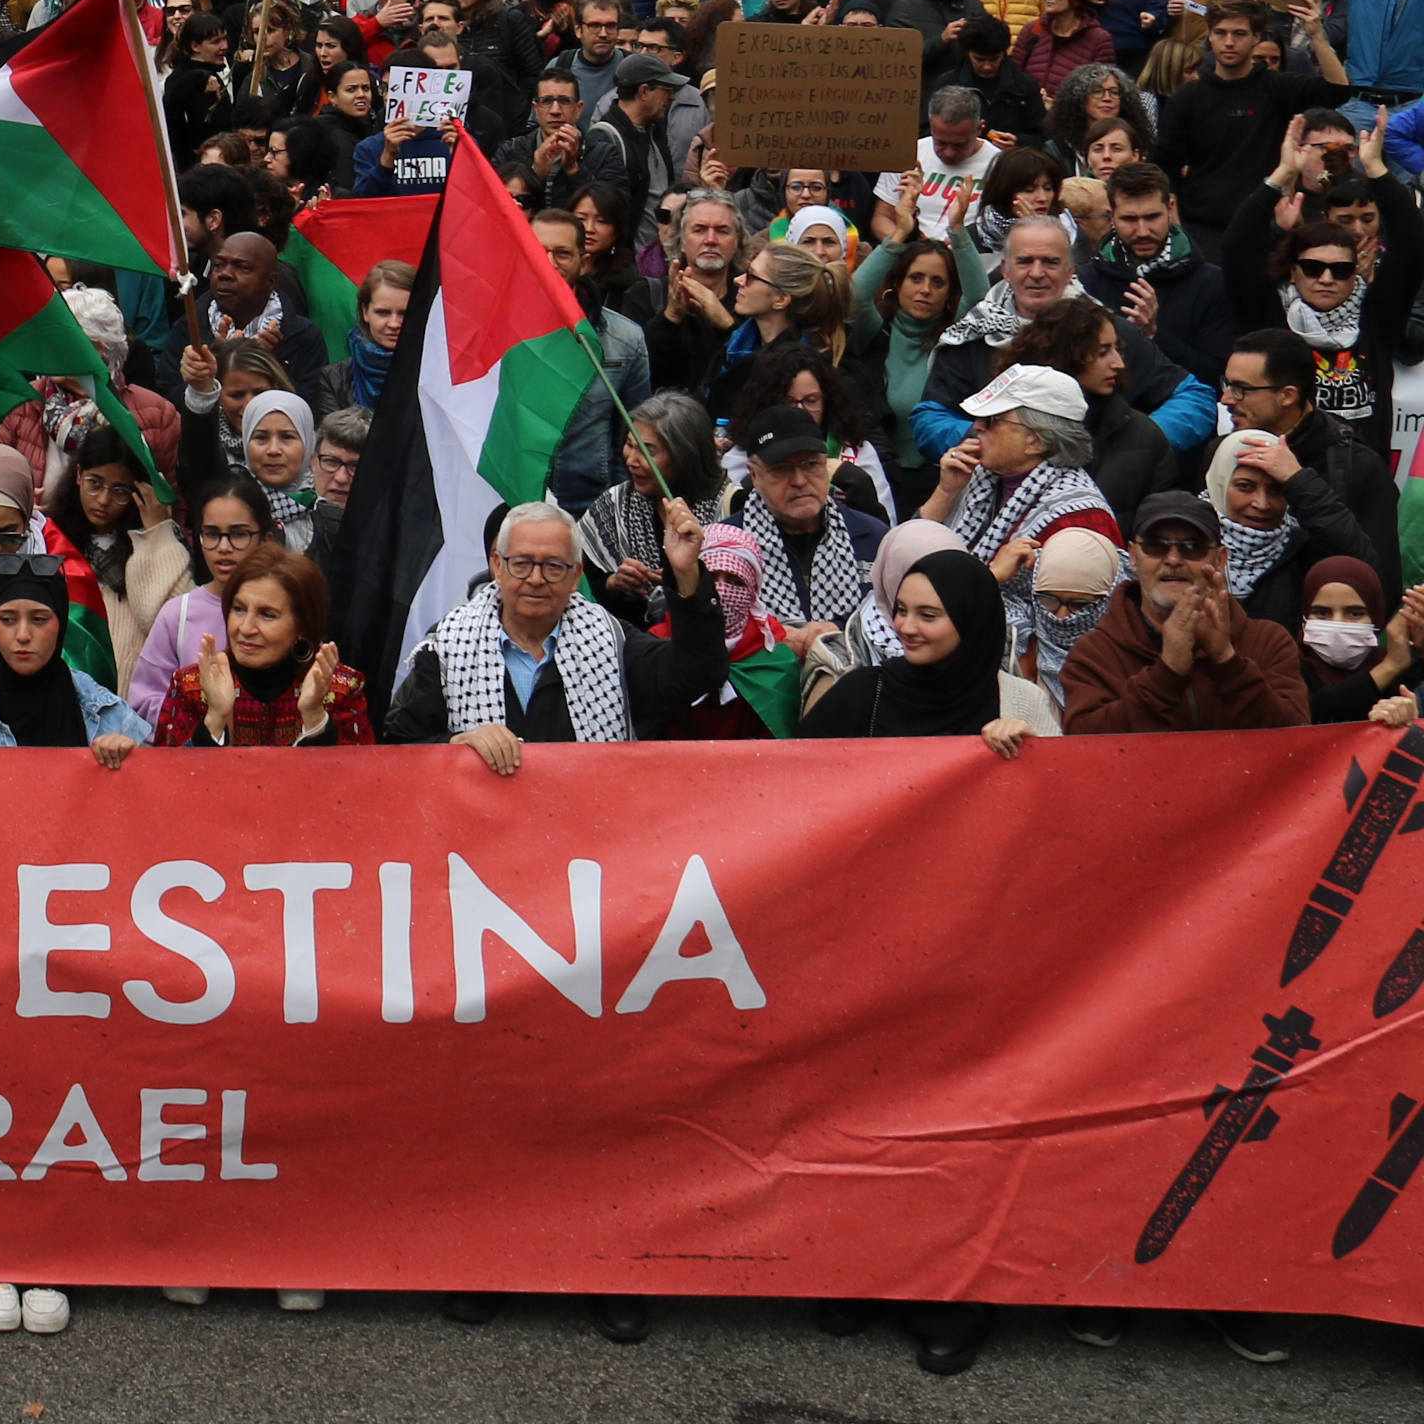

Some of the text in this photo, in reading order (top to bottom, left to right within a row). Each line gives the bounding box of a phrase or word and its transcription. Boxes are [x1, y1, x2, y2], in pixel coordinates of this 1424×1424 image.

[736, 33, 907, 56] EXPULSAR DE PALESTINA
[729, 61, 740, 76] A
[744, 63, 767, 79] LOS
[830, 62, 849, 78] LAS
[852, 64, 919, 80] MILICIAS
[402, 71, 459, 94] FREE
[729, 111, 889, 127] QUE EXTERMINEN CON
[730, 131, 752, 150] LA
[768, 151, 859, 168] PALESTINA
